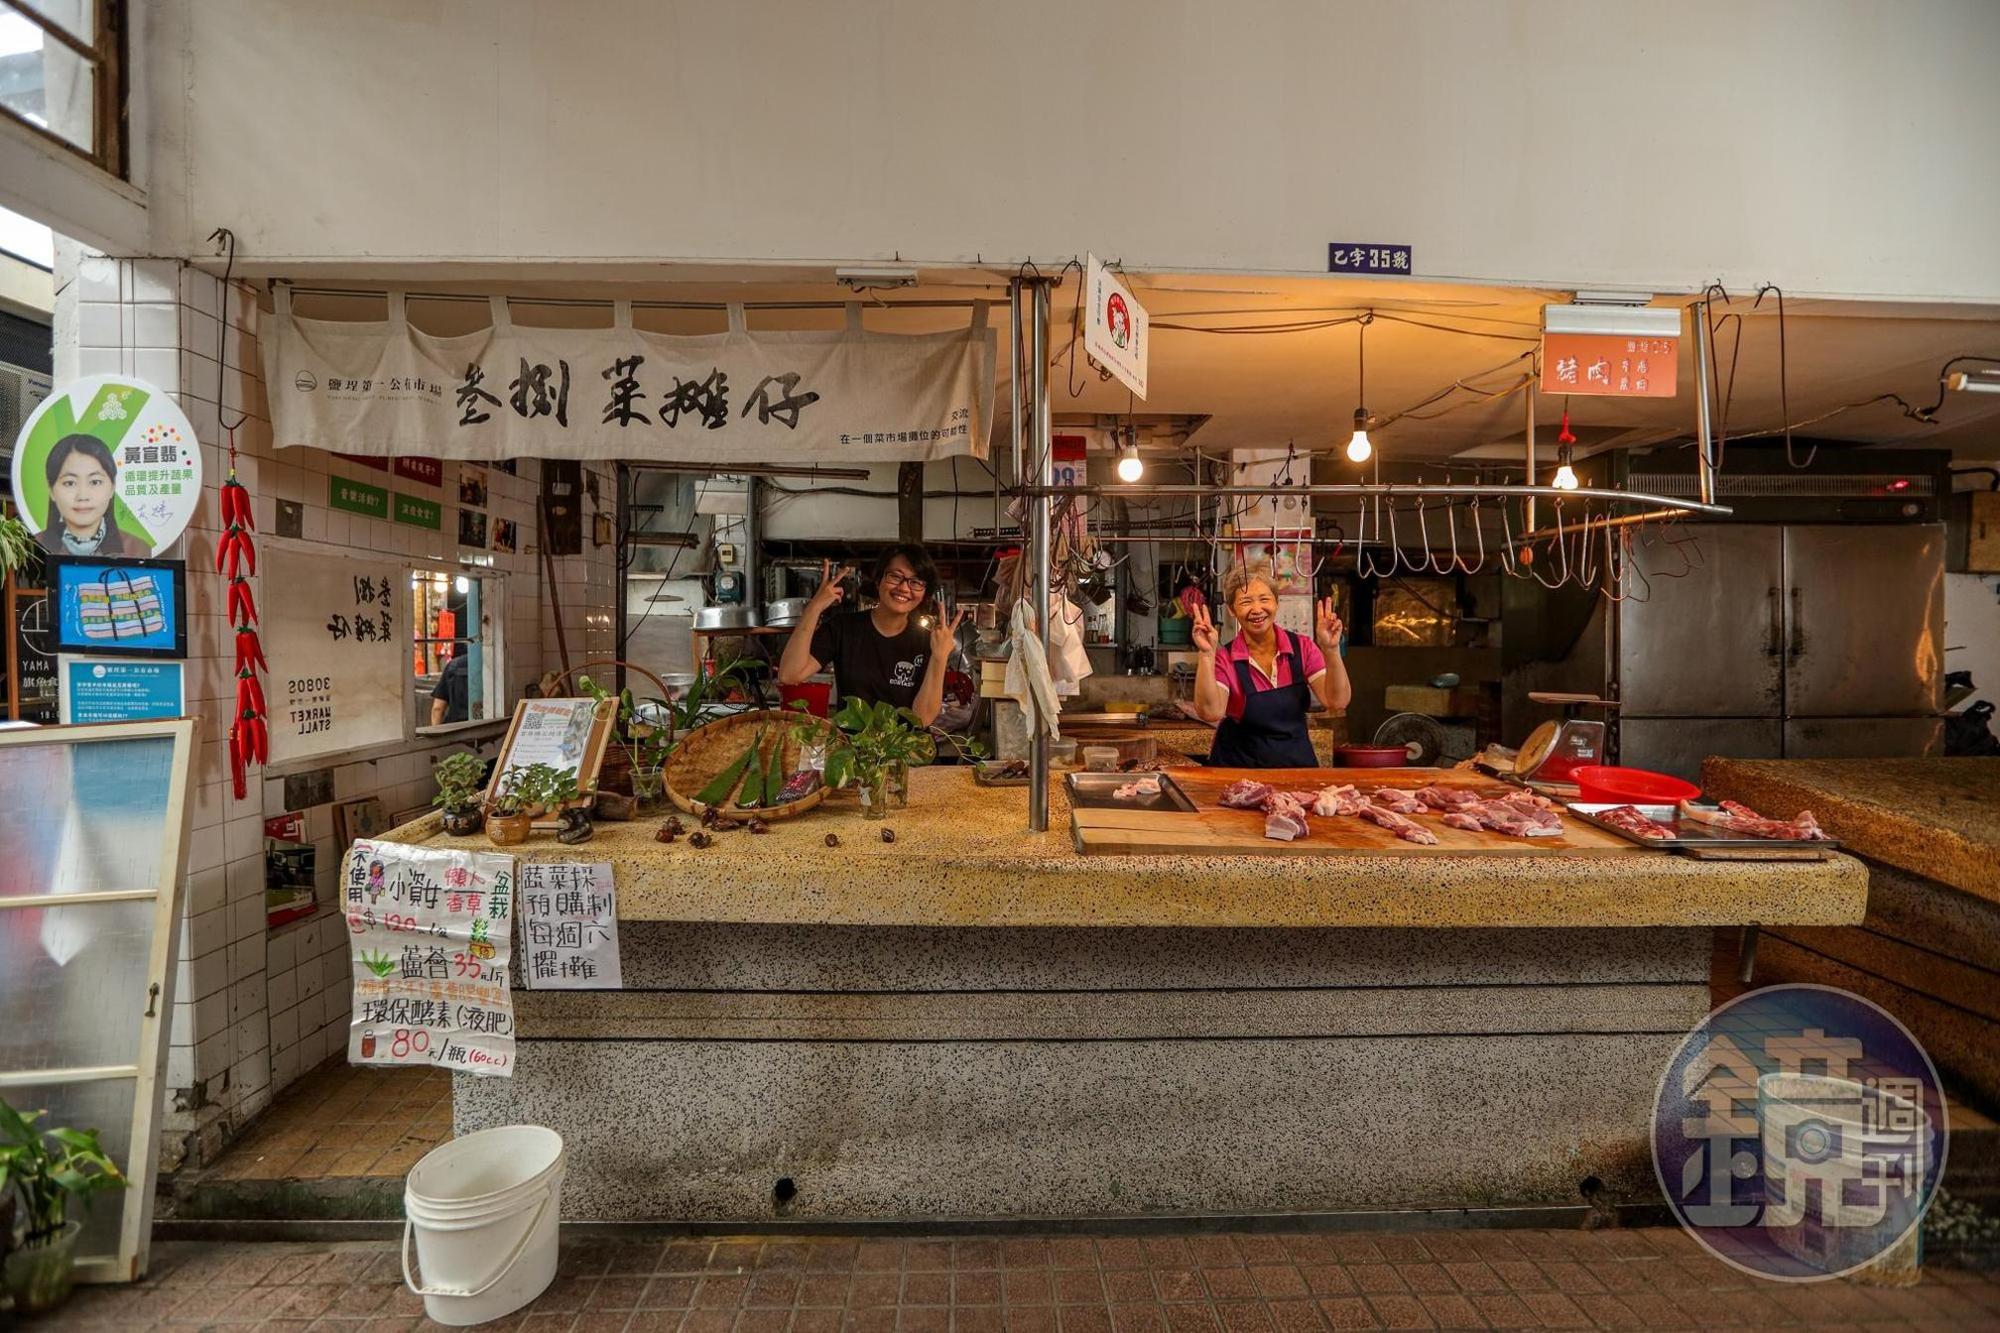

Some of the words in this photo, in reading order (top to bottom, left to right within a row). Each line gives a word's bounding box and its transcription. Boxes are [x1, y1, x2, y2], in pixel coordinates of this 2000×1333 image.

[125, 483, 182, 496] 品質及產量
[23, 660, 49, 671] YAMA
[389, 867, 442, 910] 小資女
[488, 870, 512, 920] 盆栽
[446, 893, 483, 917] 香草
[525, 892, 613, 917] 預購制
[529, 918, 611, 948] 每週六
[531, 950, 599, 980] 擺攤
